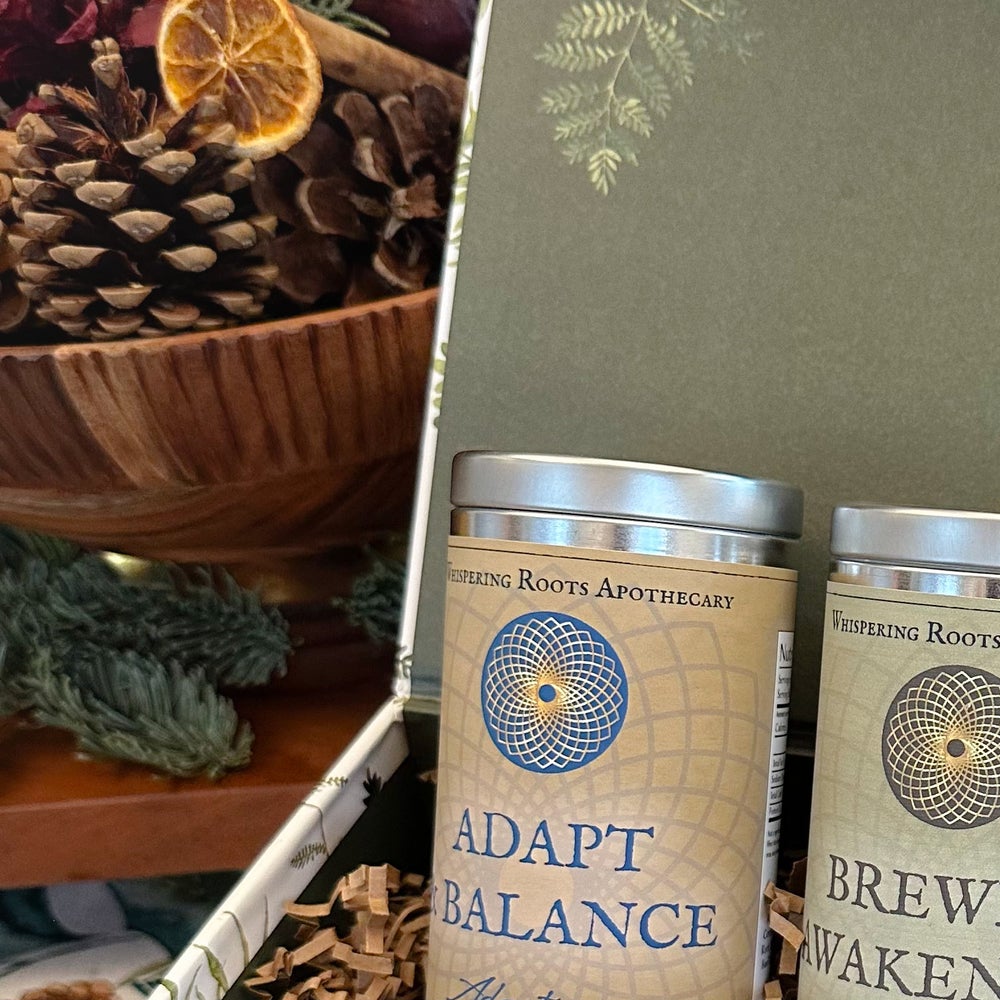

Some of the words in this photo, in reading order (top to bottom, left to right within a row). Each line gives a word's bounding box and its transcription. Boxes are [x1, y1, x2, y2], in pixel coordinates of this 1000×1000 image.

[518, 568, 589, 597] ROOTS
[595, 577, 735, 610] APOTHECARY
[832, 609, 919, 641] WHISPERING
[453, 807, 654, 872] ADAPT
[442, 878, 718, 949] BALANCE
